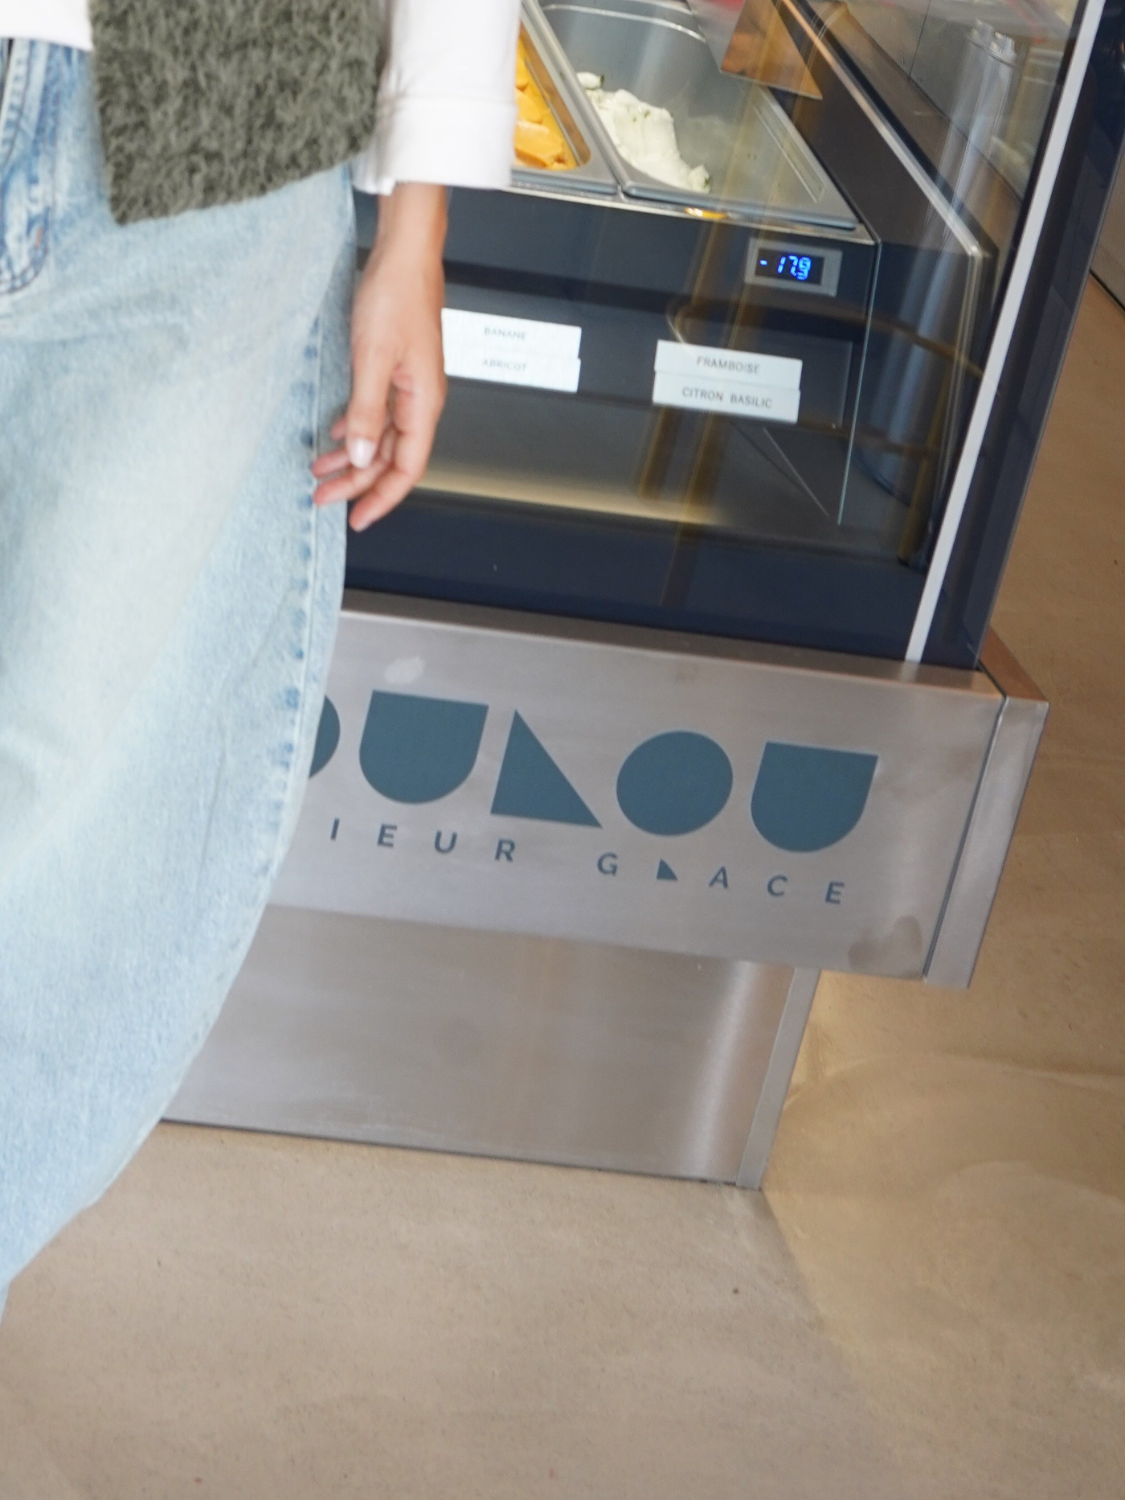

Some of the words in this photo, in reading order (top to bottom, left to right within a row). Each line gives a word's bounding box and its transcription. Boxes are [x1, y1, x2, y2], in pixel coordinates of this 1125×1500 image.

[483, 326, 527, 340] BANANE
[482, 358, 527, 371] ABRICOT
[696, 356, 761, 374] FRAMBOISE
[681, 386, 724, 402] CITRON
[730, 393, 773, 409] BASILIC
